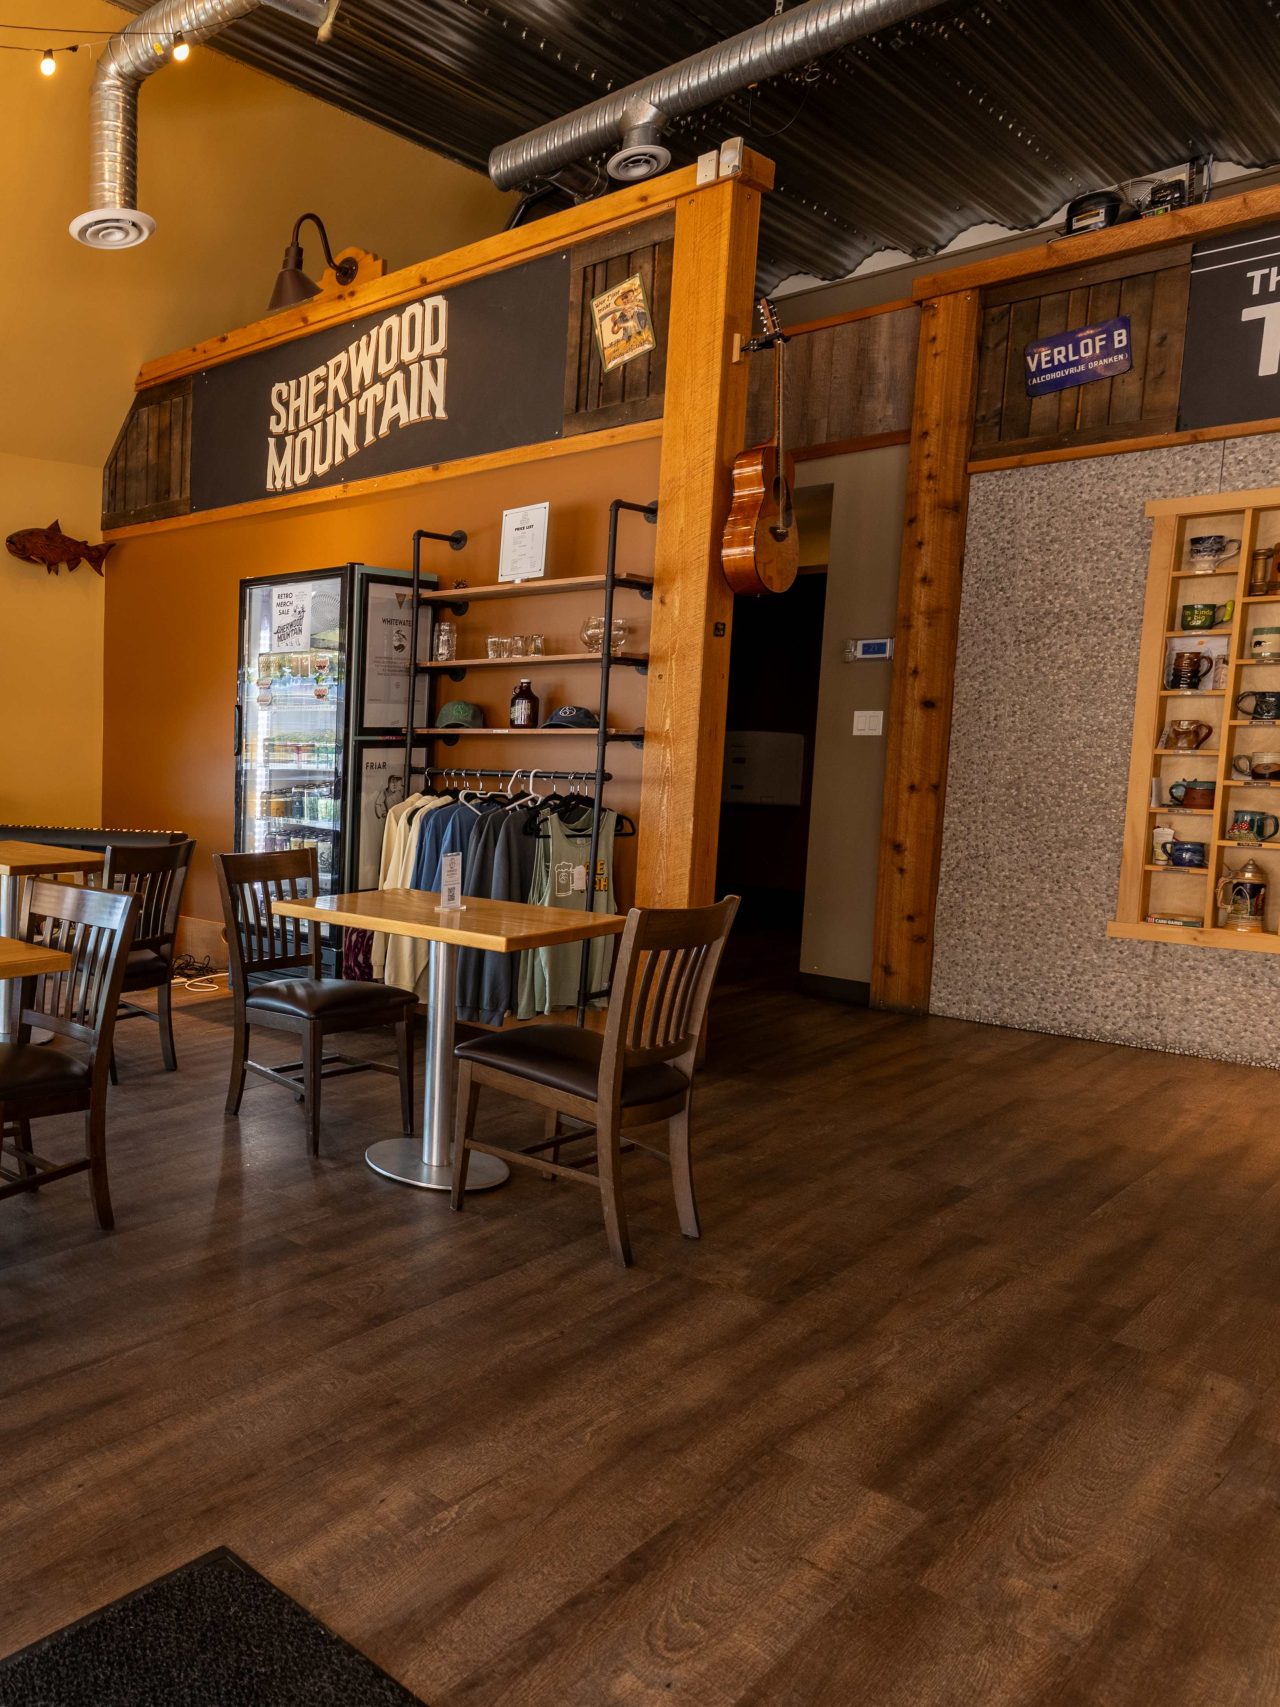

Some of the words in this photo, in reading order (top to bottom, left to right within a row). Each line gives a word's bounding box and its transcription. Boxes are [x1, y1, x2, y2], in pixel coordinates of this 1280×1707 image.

[1027, 334, 1107, 373] VERLOF
[1113, 328, 1127, 349] B
[269, 295, 448, 435] SHERWOOD
[1028, 364, 1086, 386] (ALCOHOLVRIJE
[1088, 353, 1128, 369] DRANKEN)
[266, 358, 448, 491] MOUNTAIN
[276, 600, 294, 608] MERCH
[277, 592, 294, 600] RETRO
[382, 617, 413, 628] WHITEWATE
[365, 761, 387, 770] FRIAR
